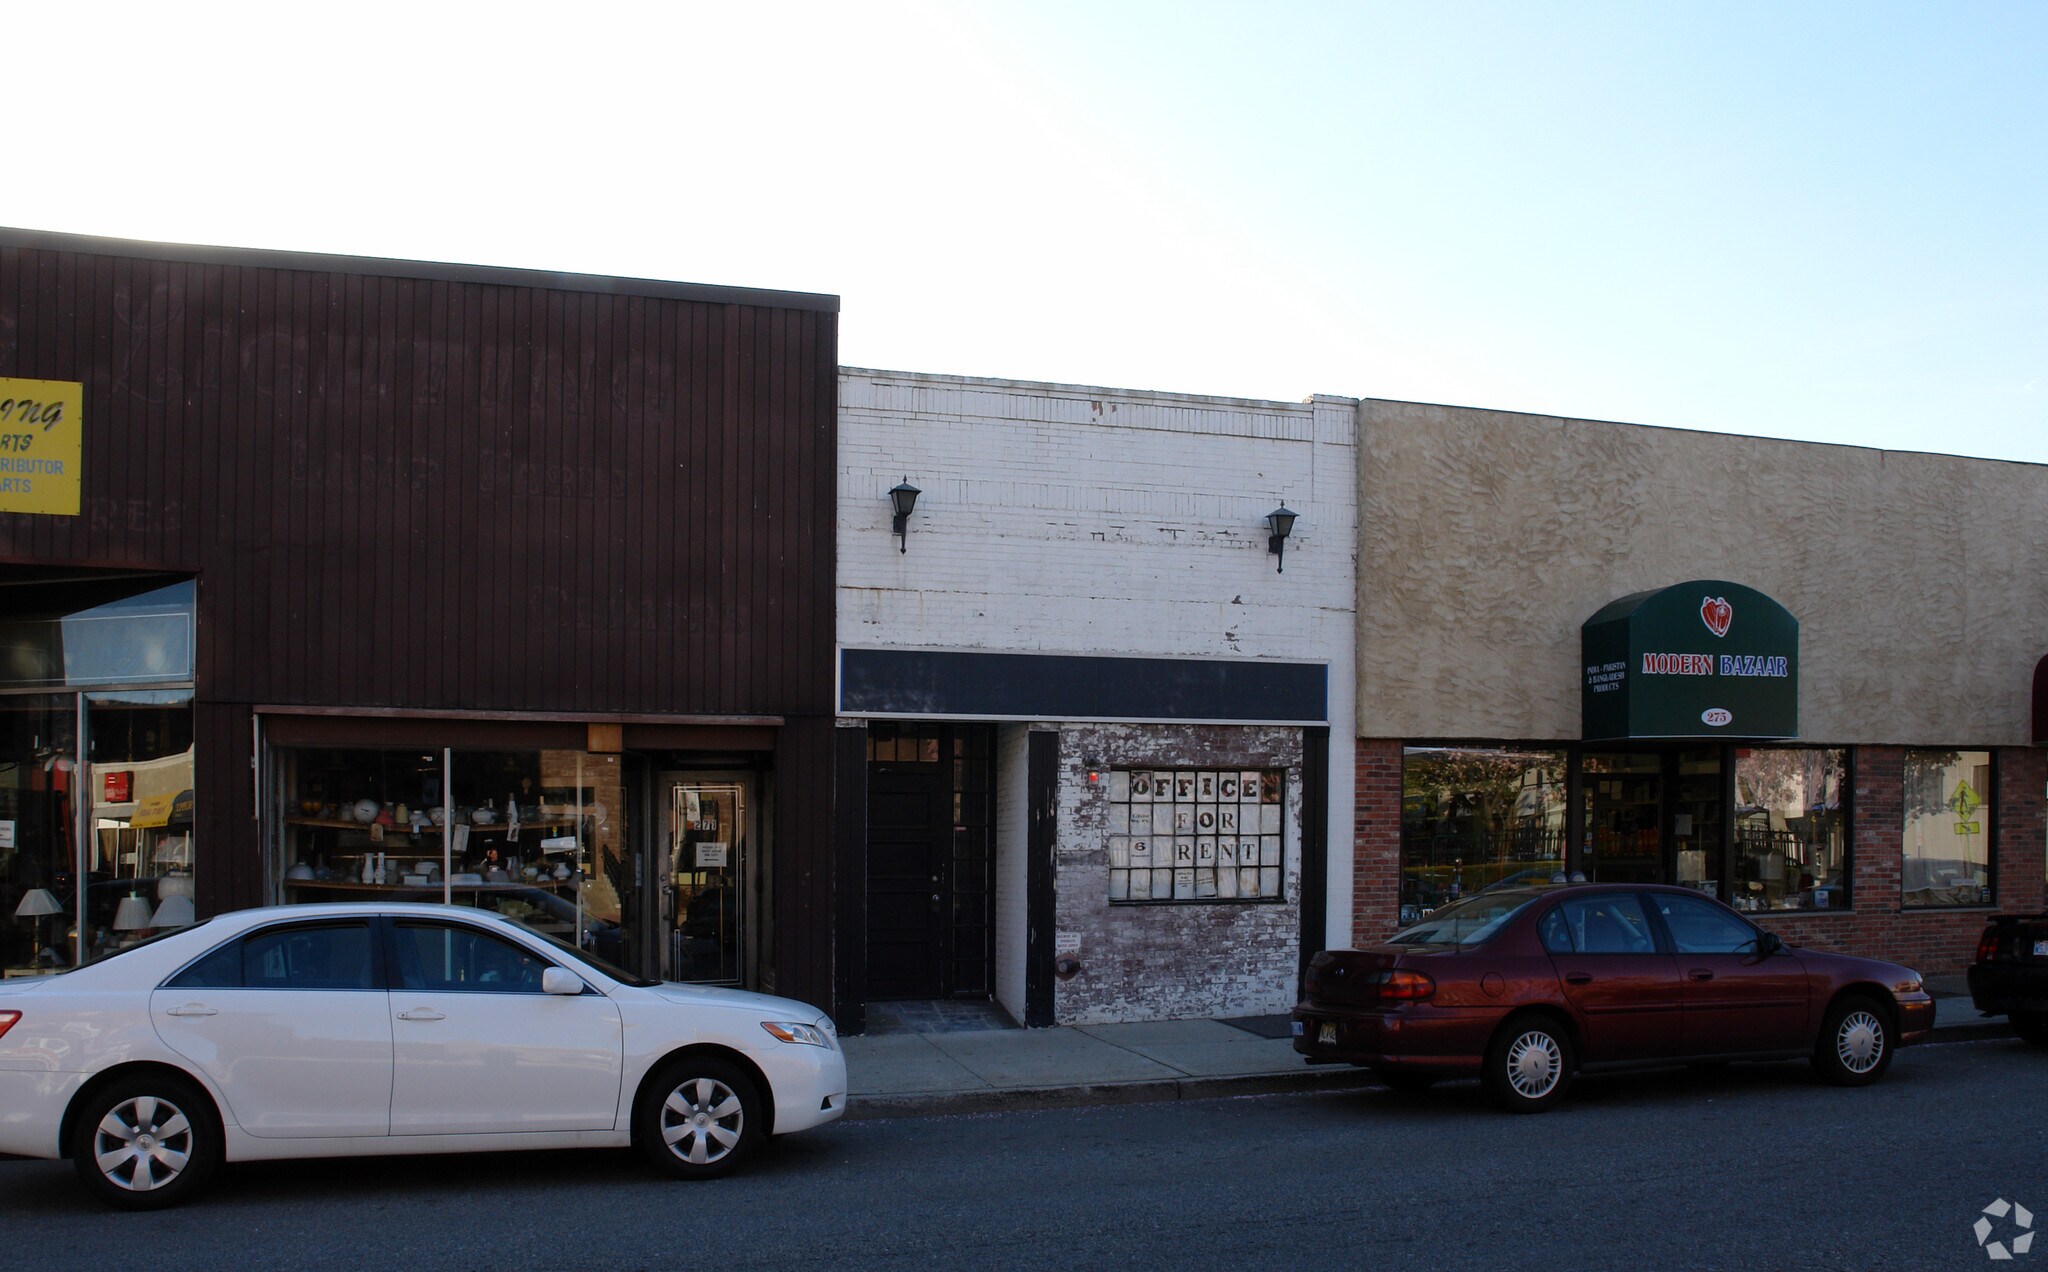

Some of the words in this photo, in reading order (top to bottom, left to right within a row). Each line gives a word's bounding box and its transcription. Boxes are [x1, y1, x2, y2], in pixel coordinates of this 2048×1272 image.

[0, 477, 32, 493] RTS
[1642, 653, 1714, 676] MODERN
[1720, 655, 1788, 678] BAZAAR
[1707, 712, 1727, 722] 275
[1132, 778, 1257, 797] OFFICE
[695, 820, 716, 830] 271
[1177, 812, 1235, 829] FOR
[1178, 843, 1256, 861] RENT
